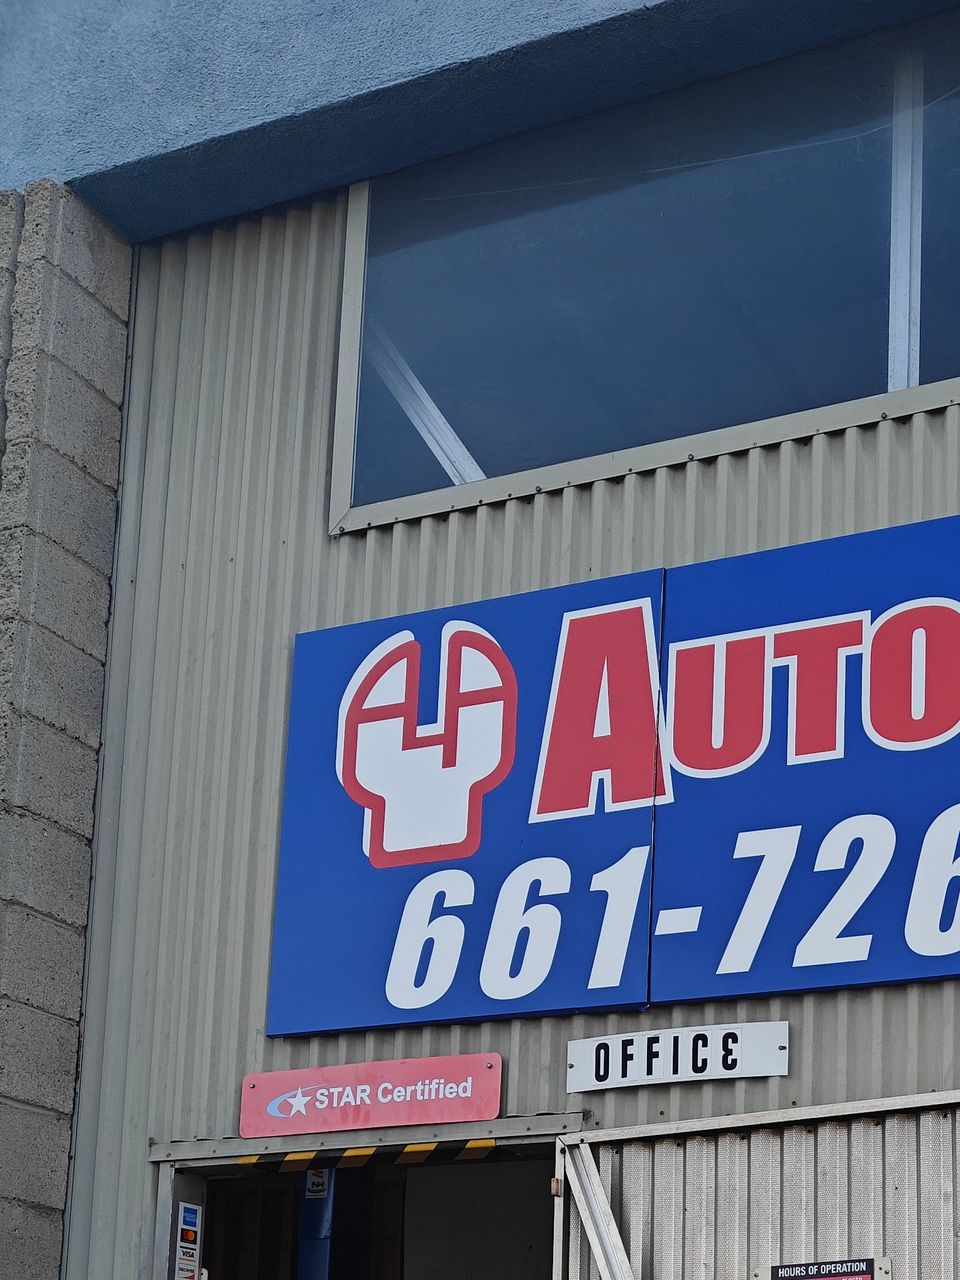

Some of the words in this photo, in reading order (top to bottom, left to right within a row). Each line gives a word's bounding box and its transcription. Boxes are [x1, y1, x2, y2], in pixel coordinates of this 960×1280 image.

[594, 1032, 740, 1083] OFFICE
[315, 1083, 371, 1110] STAR
[376, 1077, 473, 1105] Certified
[181, 1250, 195, 1258] VISA
[778, 1266, 806, 1278] HOURS
[808, 1265, 819, 1275] OF
[820, 1261, 867, 1274] OPERATION
